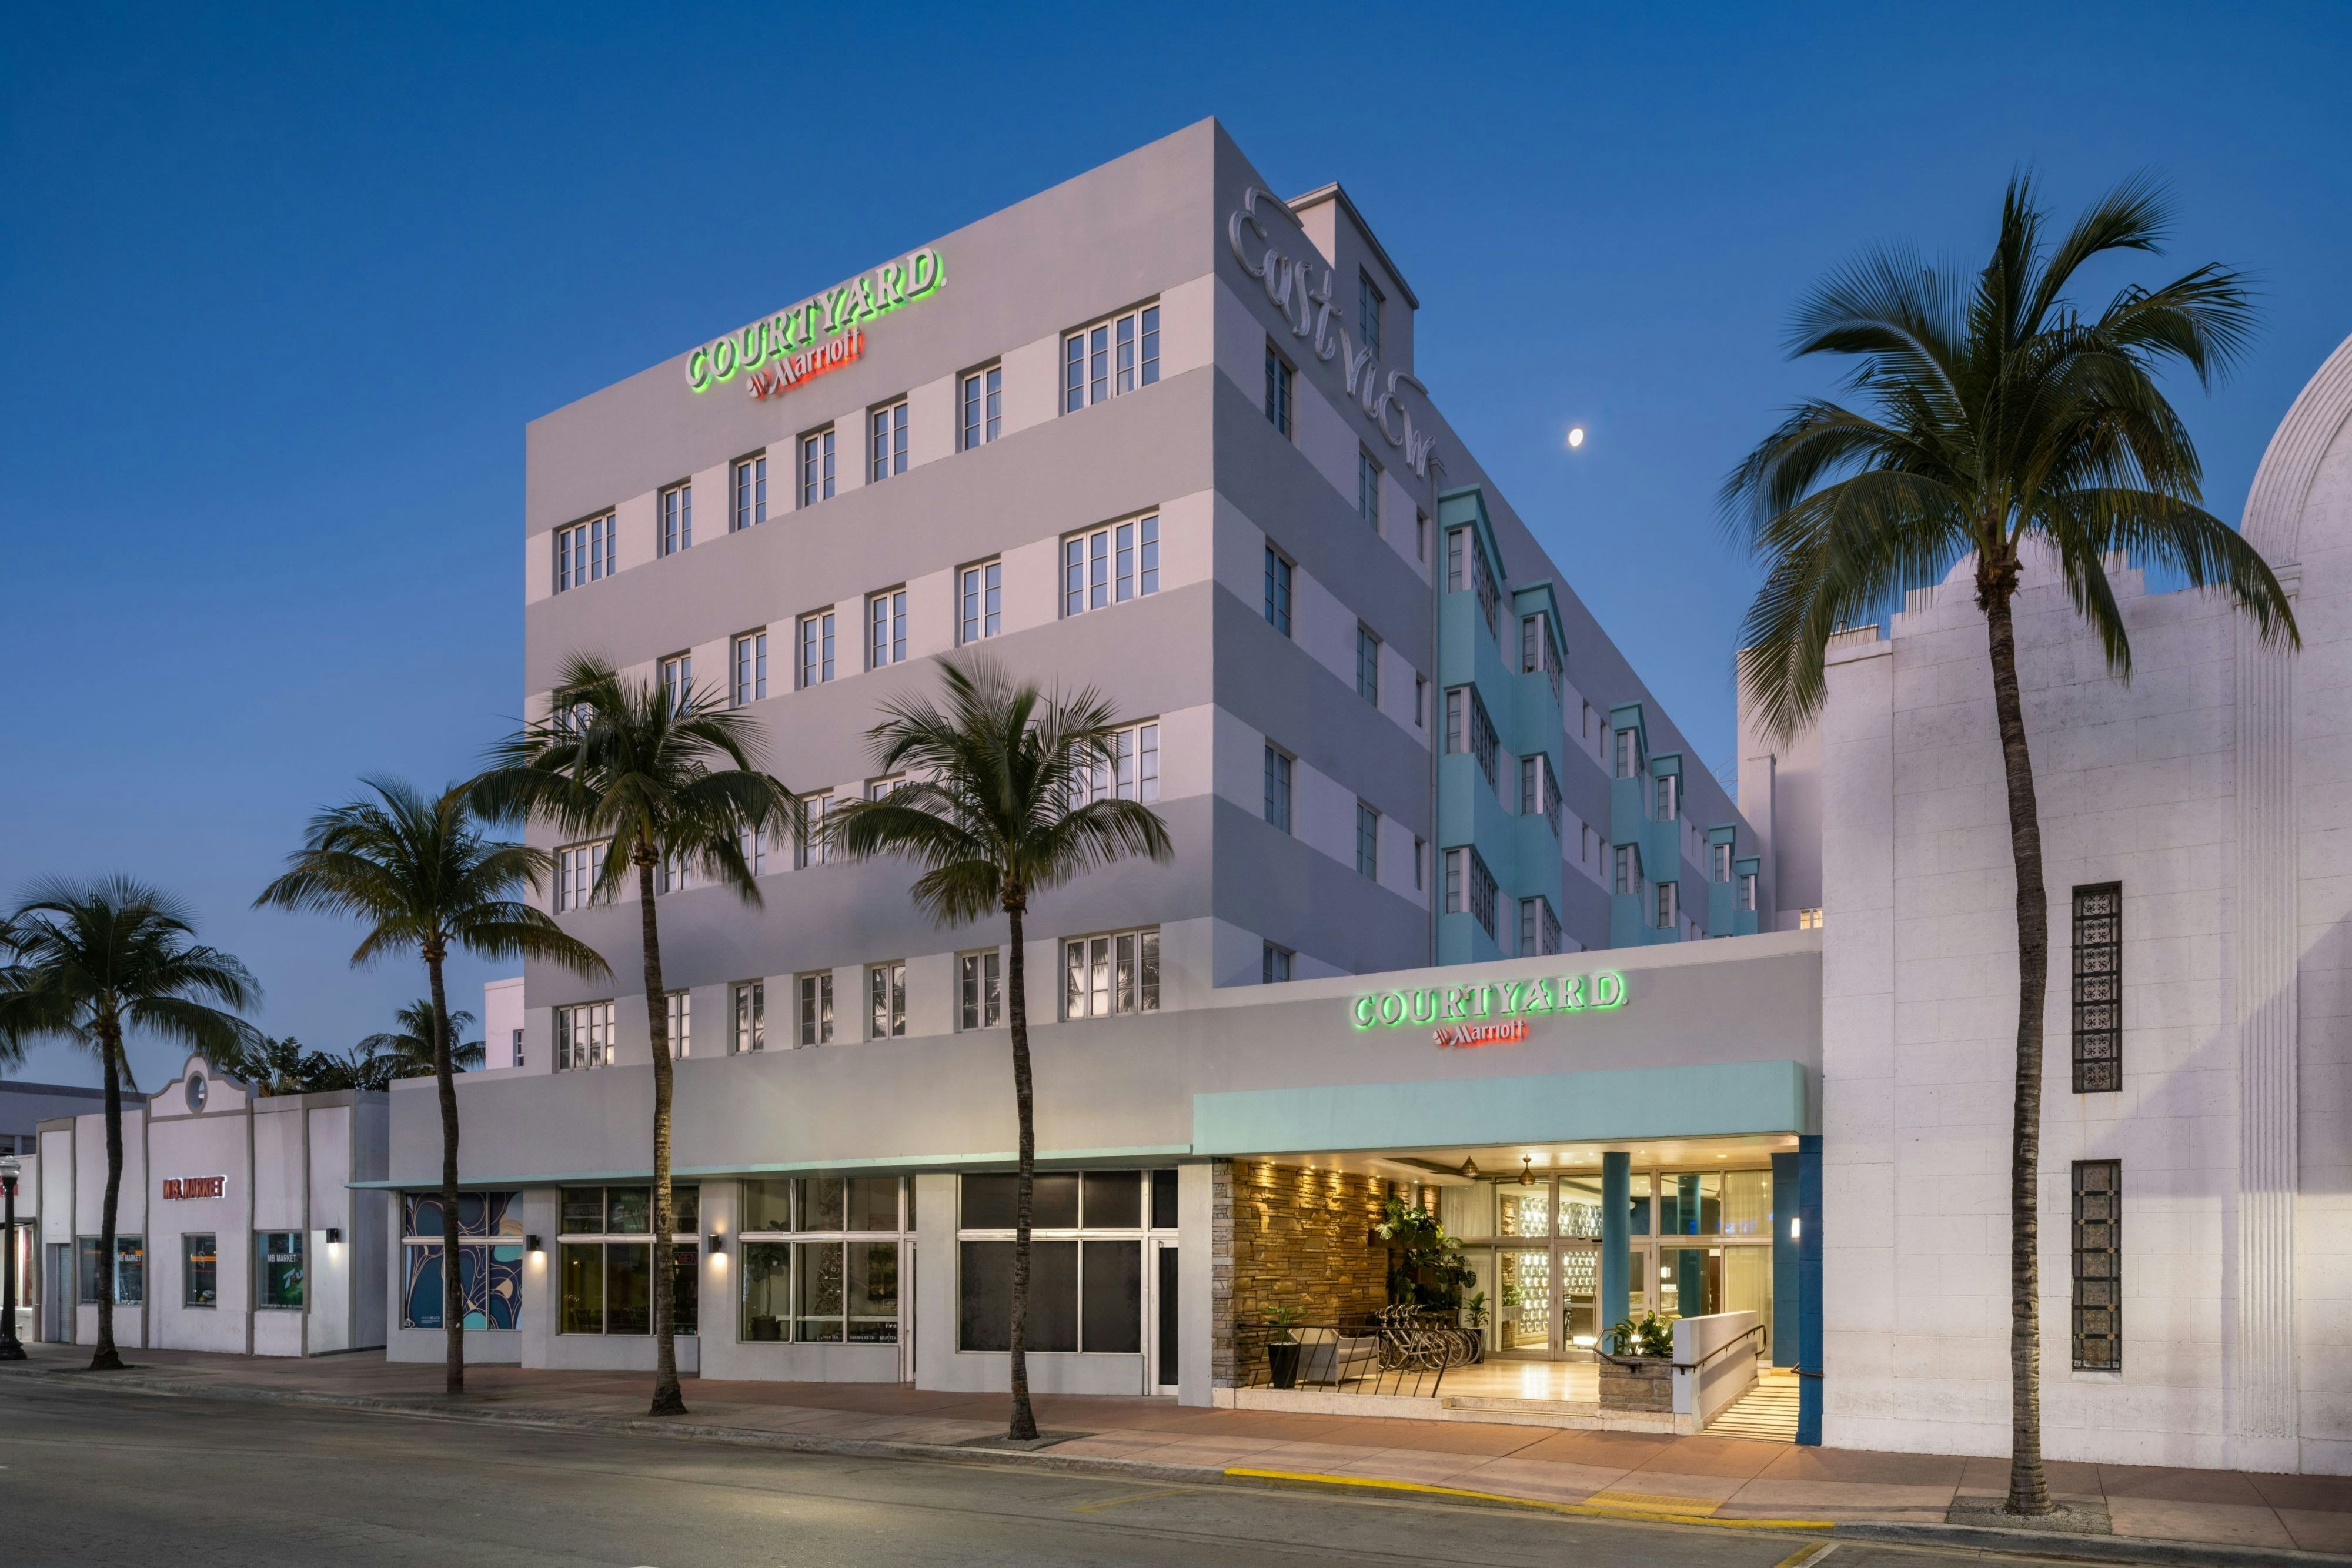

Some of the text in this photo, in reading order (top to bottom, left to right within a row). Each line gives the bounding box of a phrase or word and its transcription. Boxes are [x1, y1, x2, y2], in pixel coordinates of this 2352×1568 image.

[685, 248, 939, 388] COURTYARD
[769, 326, 861, 394] Marriott
[1451, 1020, 1524, 1045] Marriott
[182, 1176, 225, 1199] MARKET
[674, 1253, 697, 1263] OPEN
